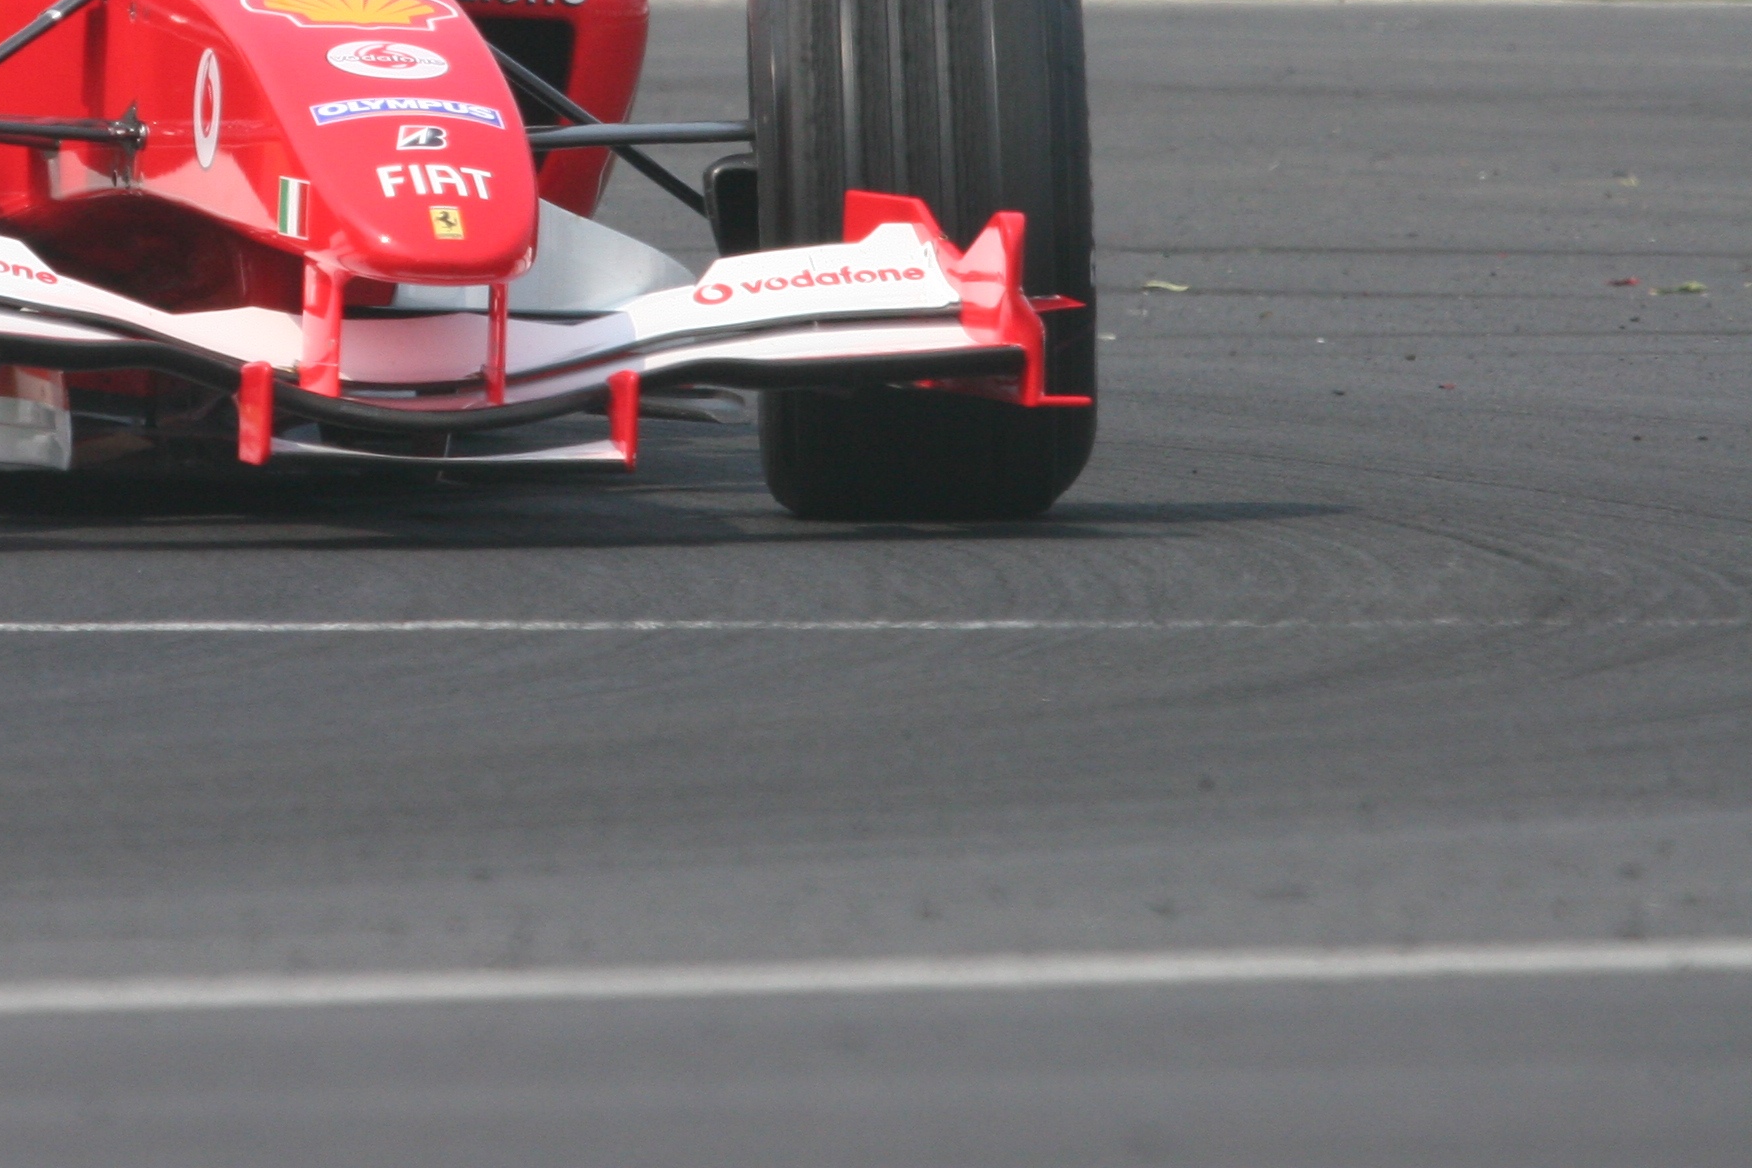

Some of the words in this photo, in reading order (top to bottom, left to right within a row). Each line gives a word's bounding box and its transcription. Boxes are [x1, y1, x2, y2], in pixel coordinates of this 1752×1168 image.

[330, 49, 447, 67] vodafone
[317, 99, 496, 120] OLYMPUS
[376, 164, 491, 199] FIAT
[740, 266, 925, 295] vodafone
